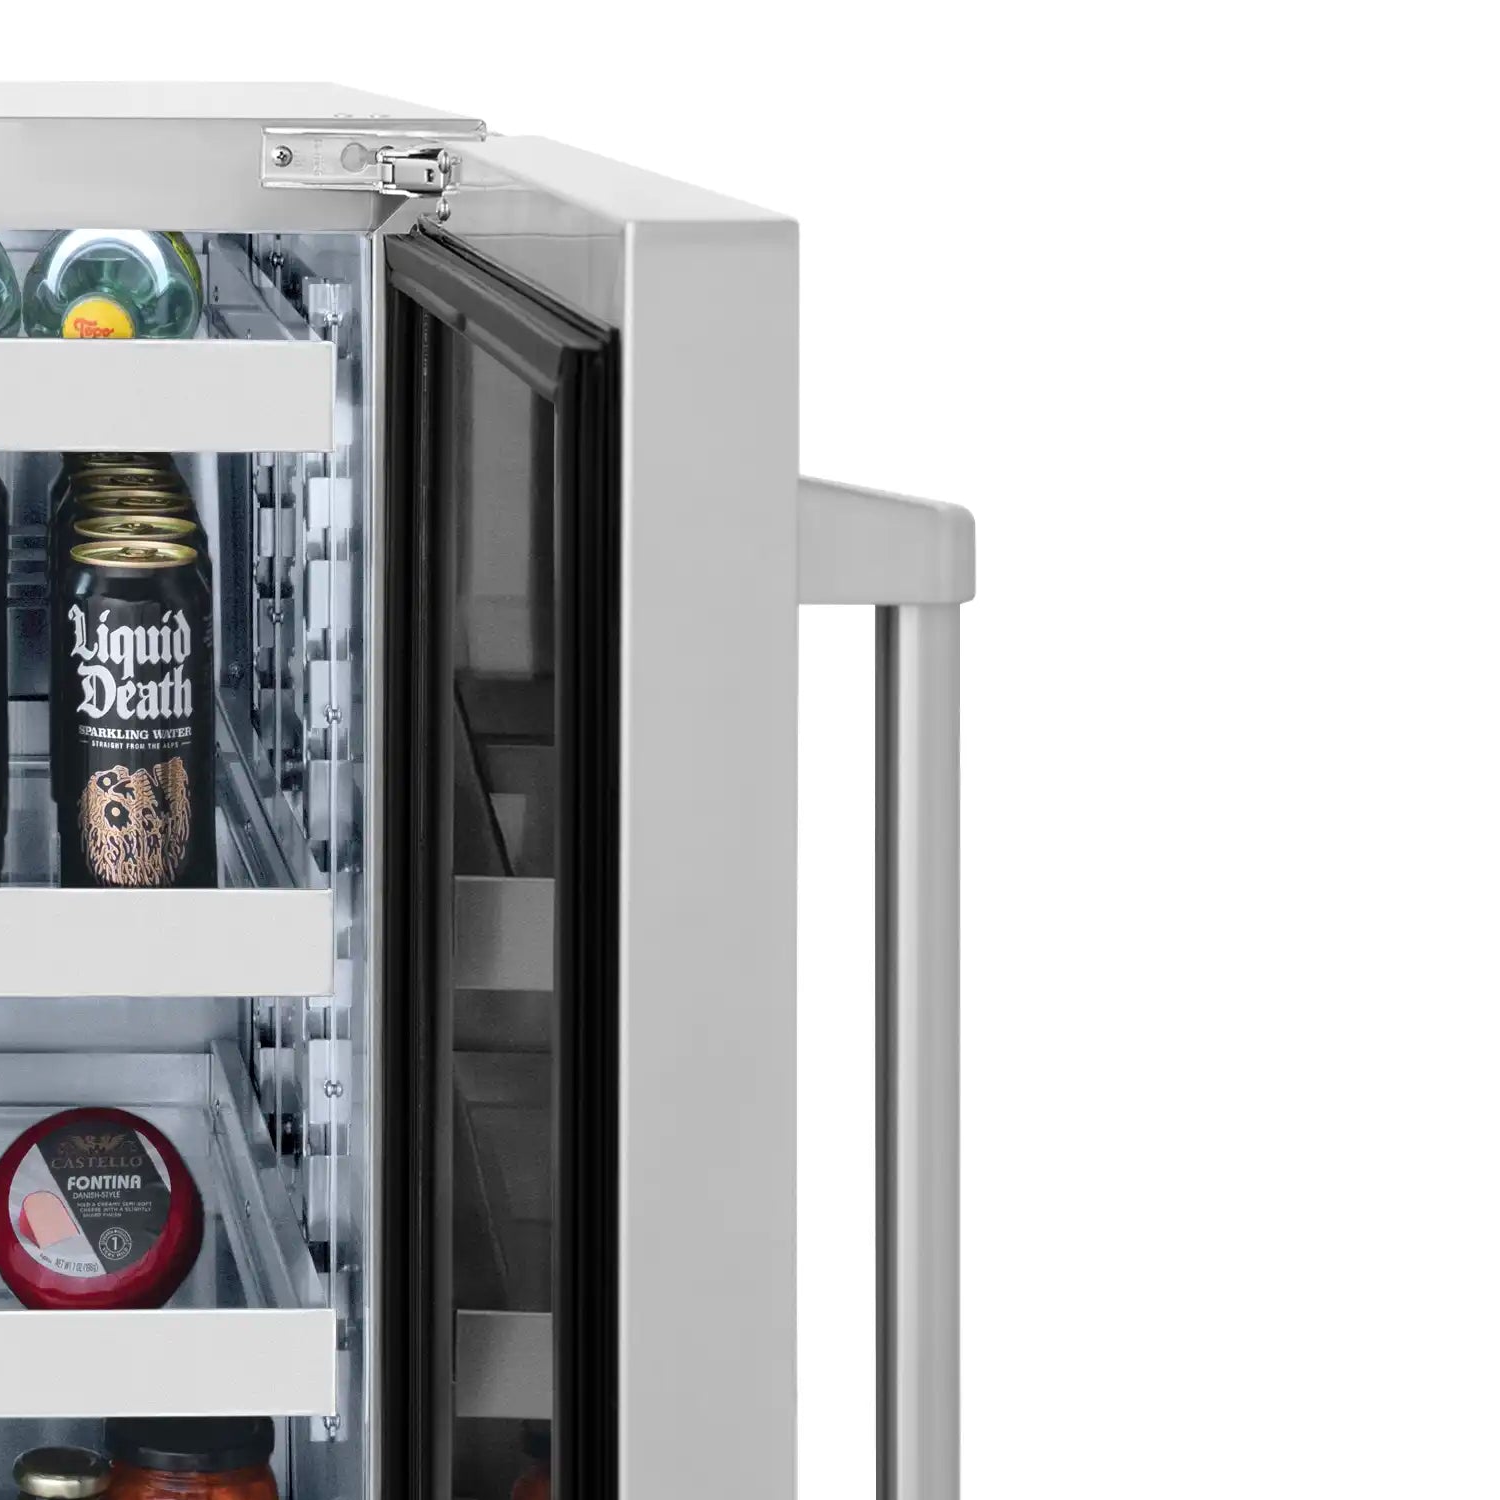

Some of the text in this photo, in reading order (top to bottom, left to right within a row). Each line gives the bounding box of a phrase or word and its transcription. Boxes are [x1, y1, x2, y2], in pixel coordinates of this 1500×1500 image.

[73, 317, 115, 339] Topo
[68, 603, 191, 680] Liquid
[76, 663, 193, 721] Death
[78, 724, 192, 740] SPARKLING WATER
[92, 740, 123, 750] STRAIGHT
[51, 1155, 143, 1170] CASTELLO
[67, 1174, 142, 1191] FONTINA
[72, 1191, 121, 1200] DANISH-STYLE
[111, 1236, 118, 1250] 1
